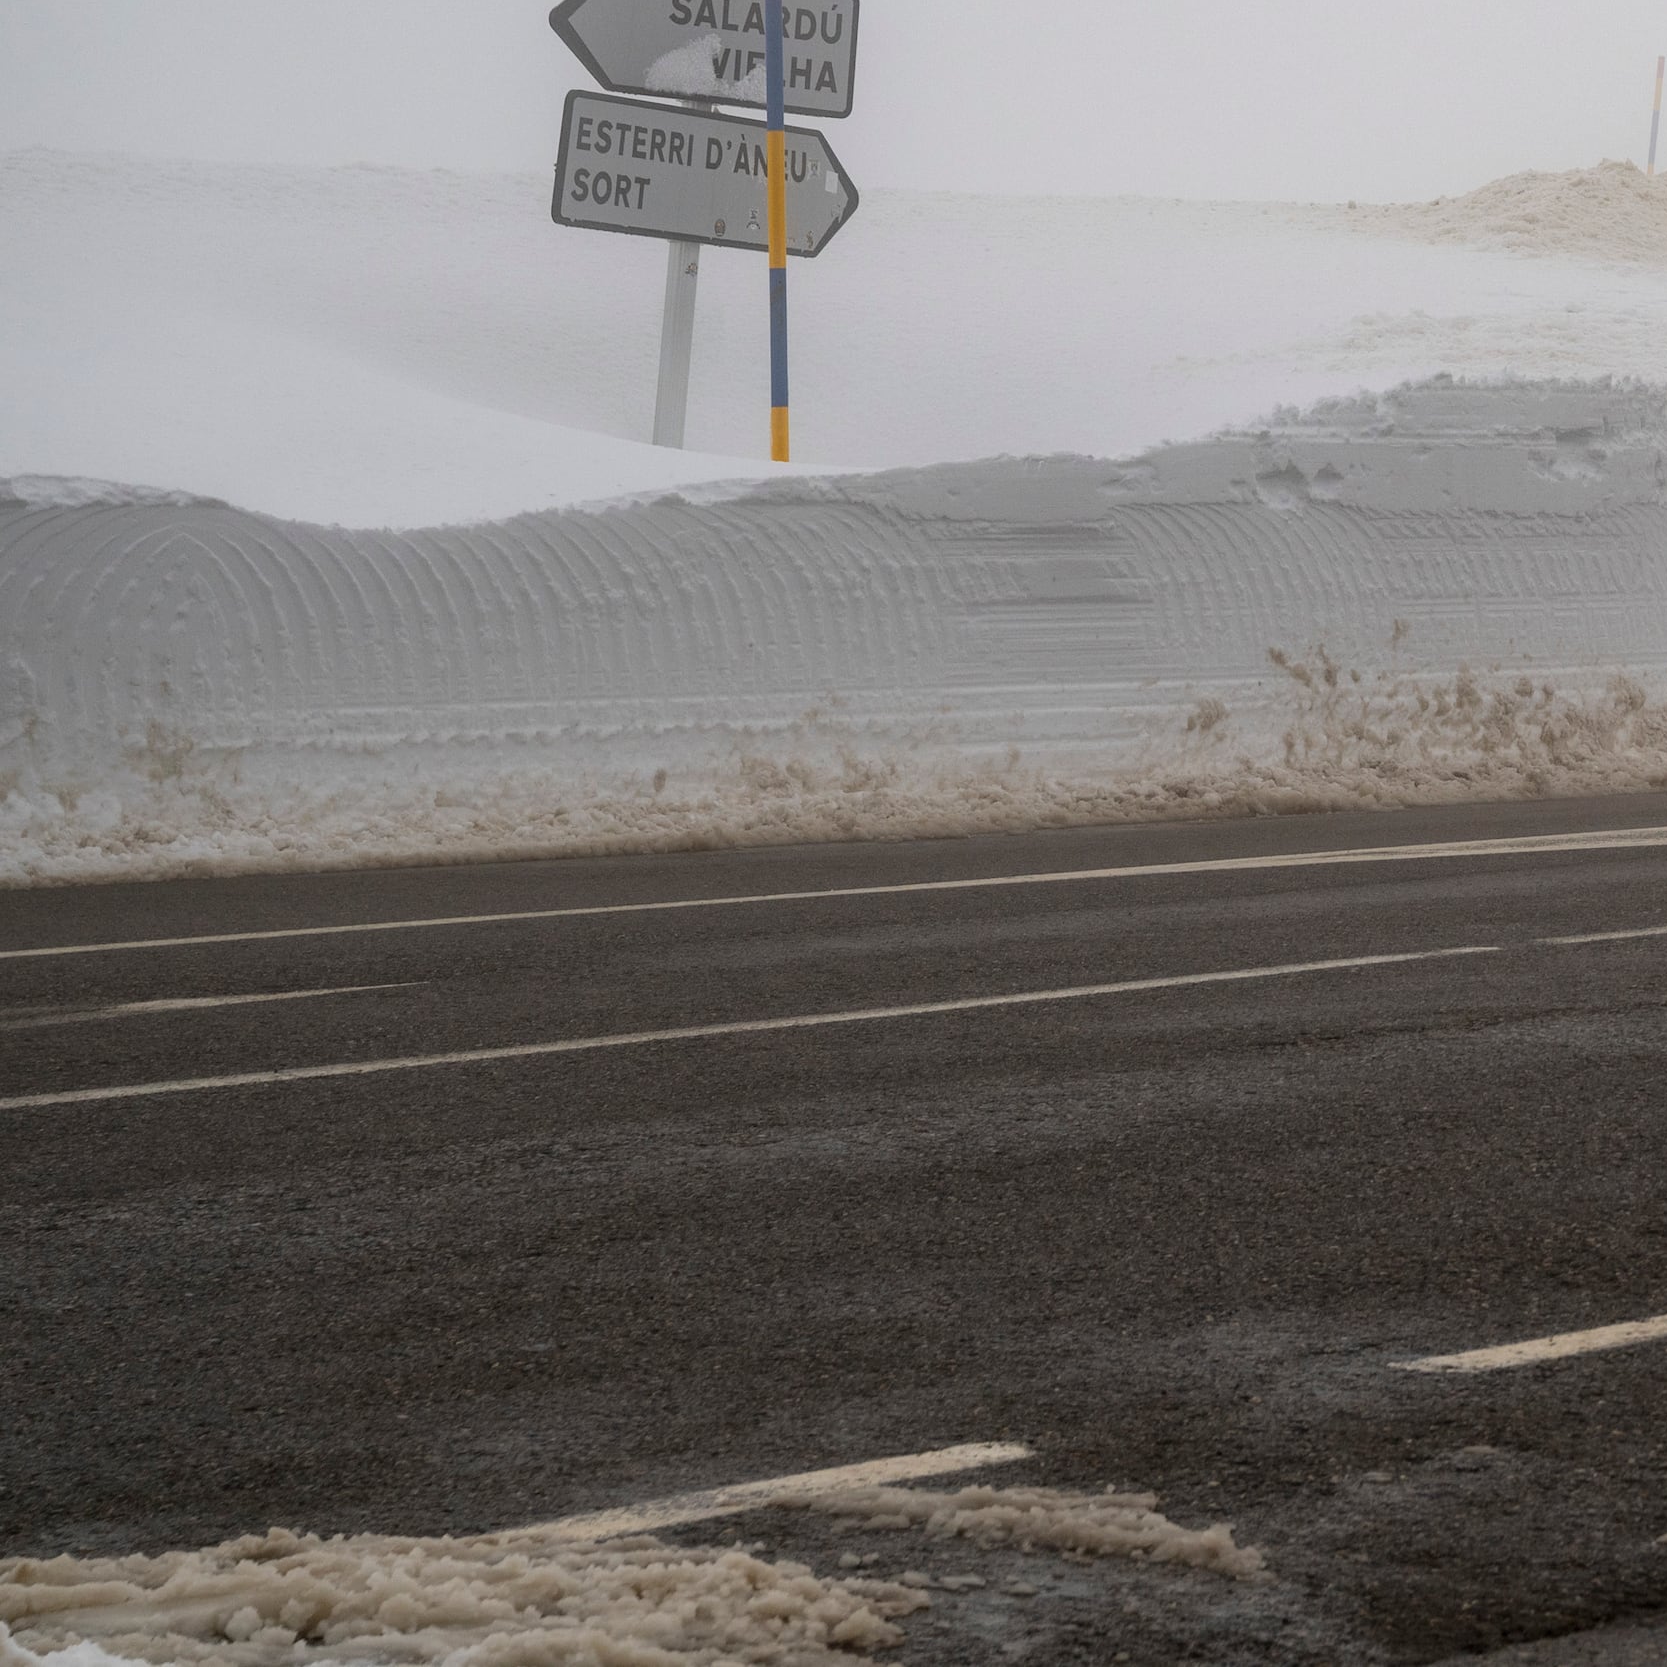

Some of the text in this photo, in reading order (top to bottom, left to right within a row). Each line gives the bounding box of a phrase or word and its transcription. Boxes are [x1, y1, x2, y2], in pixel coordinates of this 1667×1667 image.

[576, 117, 807, 183] ESTERRI D'ÀNU
[571, 167, 651, 210] SORT
